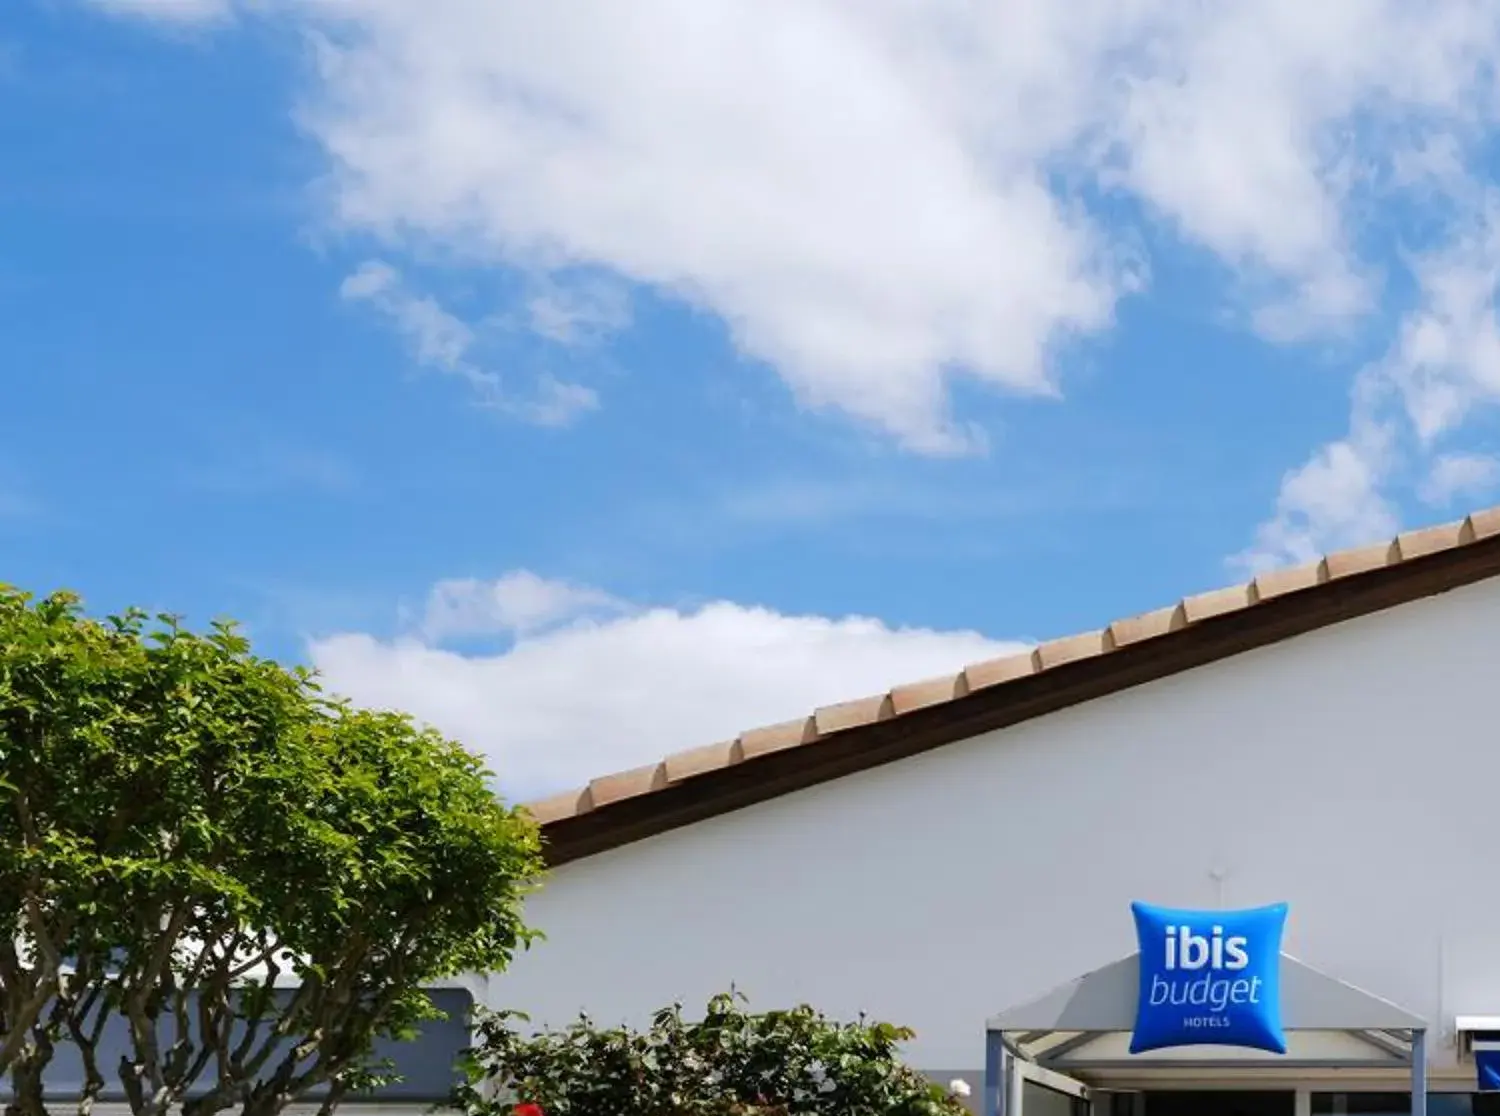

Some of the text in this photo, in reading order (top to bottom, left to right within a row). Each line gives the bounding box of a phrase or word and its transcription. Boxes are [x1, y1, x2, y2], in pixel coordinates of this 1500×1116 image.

[1165, 925, 1249, 970] ibis
[1150, 973, 1262, 1012] budget
[1183, 1016, 1230, 1028] HOTELS
